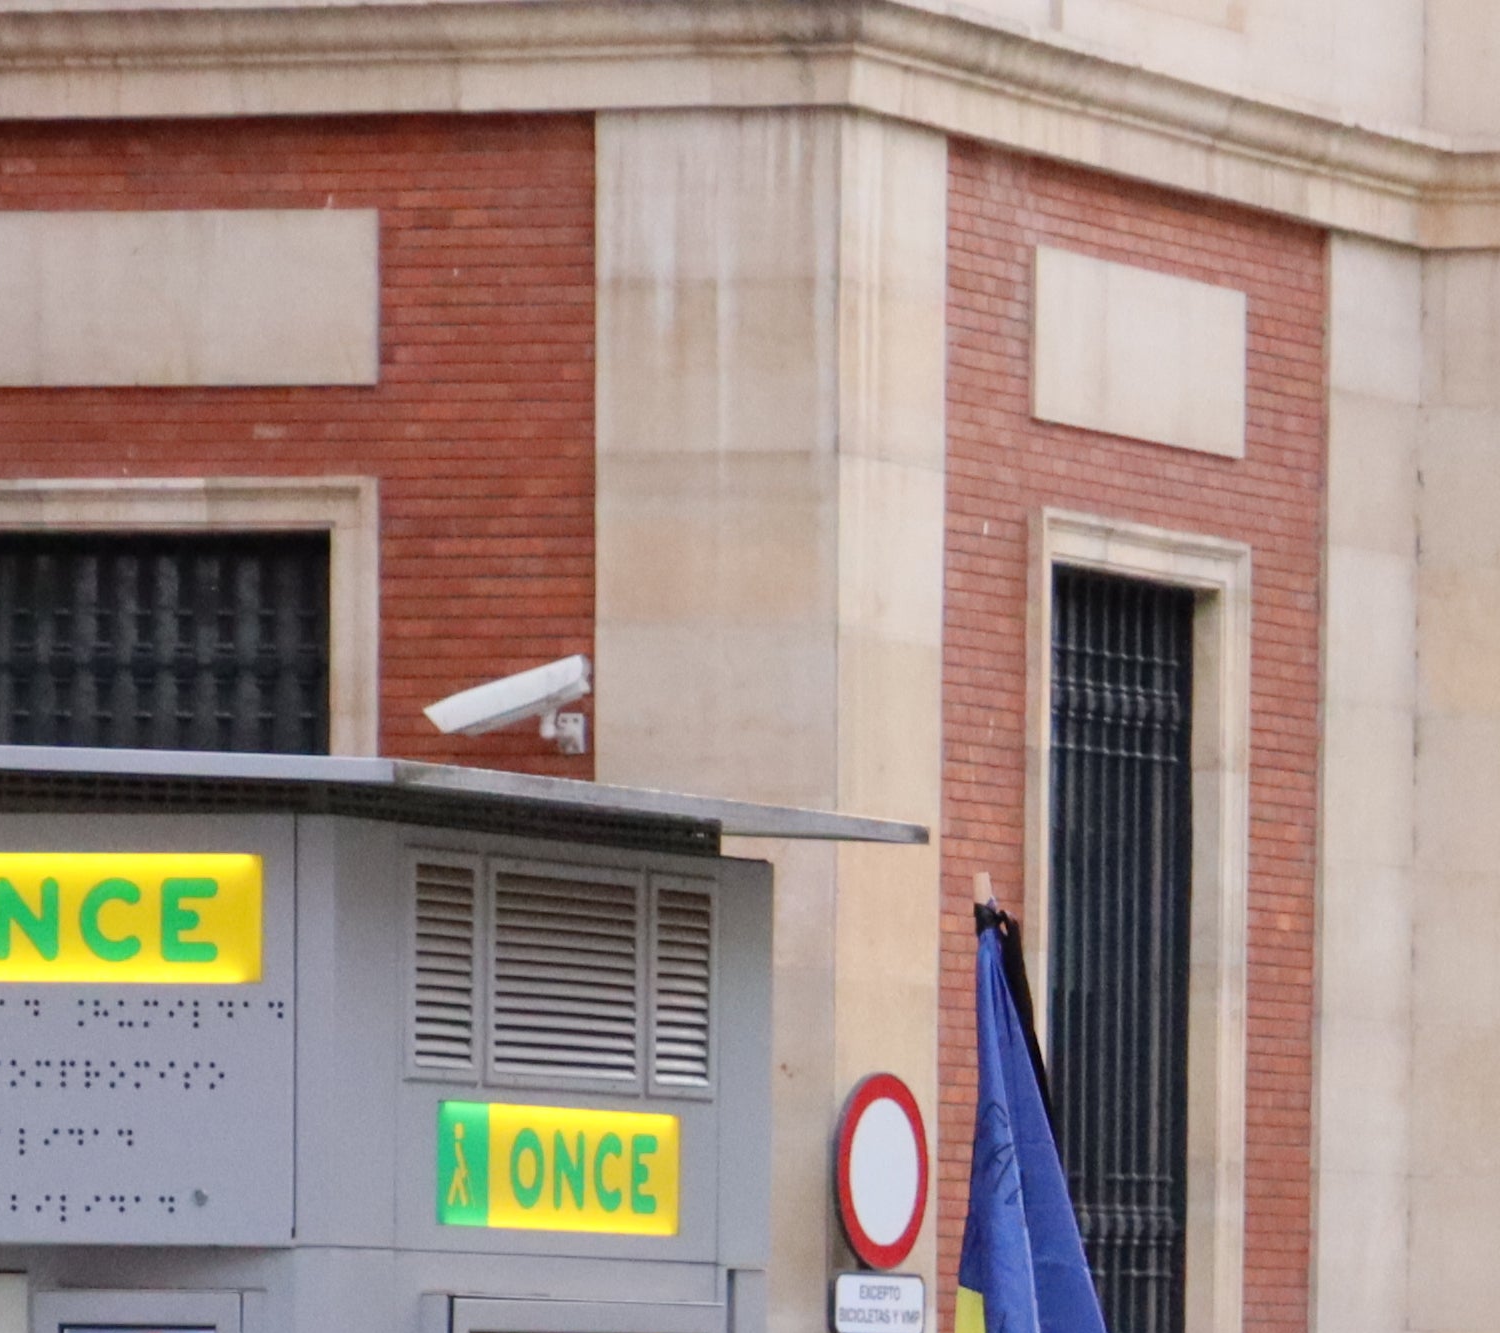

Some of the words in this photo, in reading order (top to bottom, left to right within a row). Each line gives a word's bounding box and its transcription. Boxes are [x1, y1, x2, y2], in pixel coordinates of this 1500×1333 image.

[510, 1127, 658, 1214] ONCE
[860, 1285, 901, 1301] EXCEPTO
[839, 1307, 890, 1324] BICICLETAS
[893, 1310, 899, 1323] Y
[902, 1310, 920, 1324] VMP
